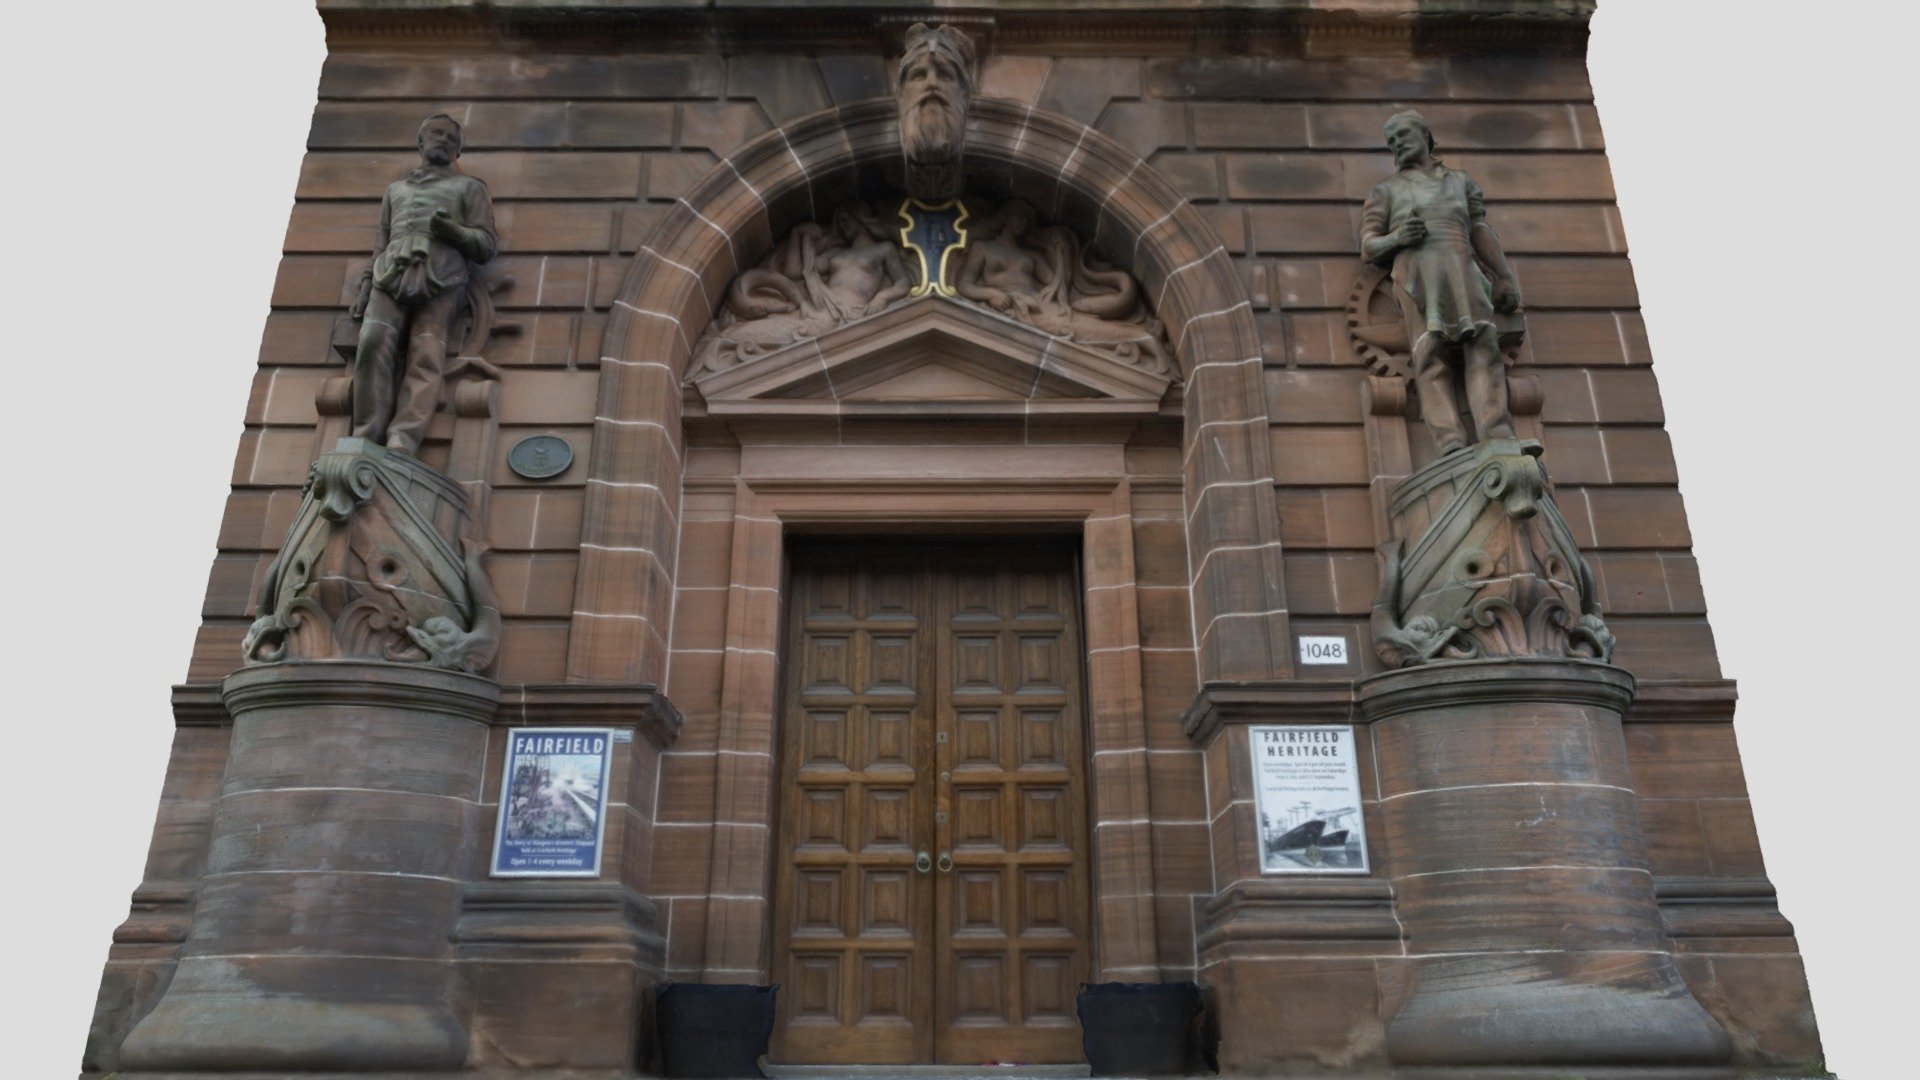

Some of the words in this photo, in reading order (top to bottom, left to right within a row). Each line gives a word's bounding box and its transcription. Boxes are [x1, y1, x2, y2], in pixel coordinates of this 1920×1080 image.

[1306, 643, 1342, 658] 1048
[1264, 732, 1339, 742] FAIRFIELD
[515, 737, 604, 753] FAIRFIELD
[1268, 746, 1338, 756] HERITAGE
[511, 858, 526, 866] Open
[556, 858, 583, 867] weekday
